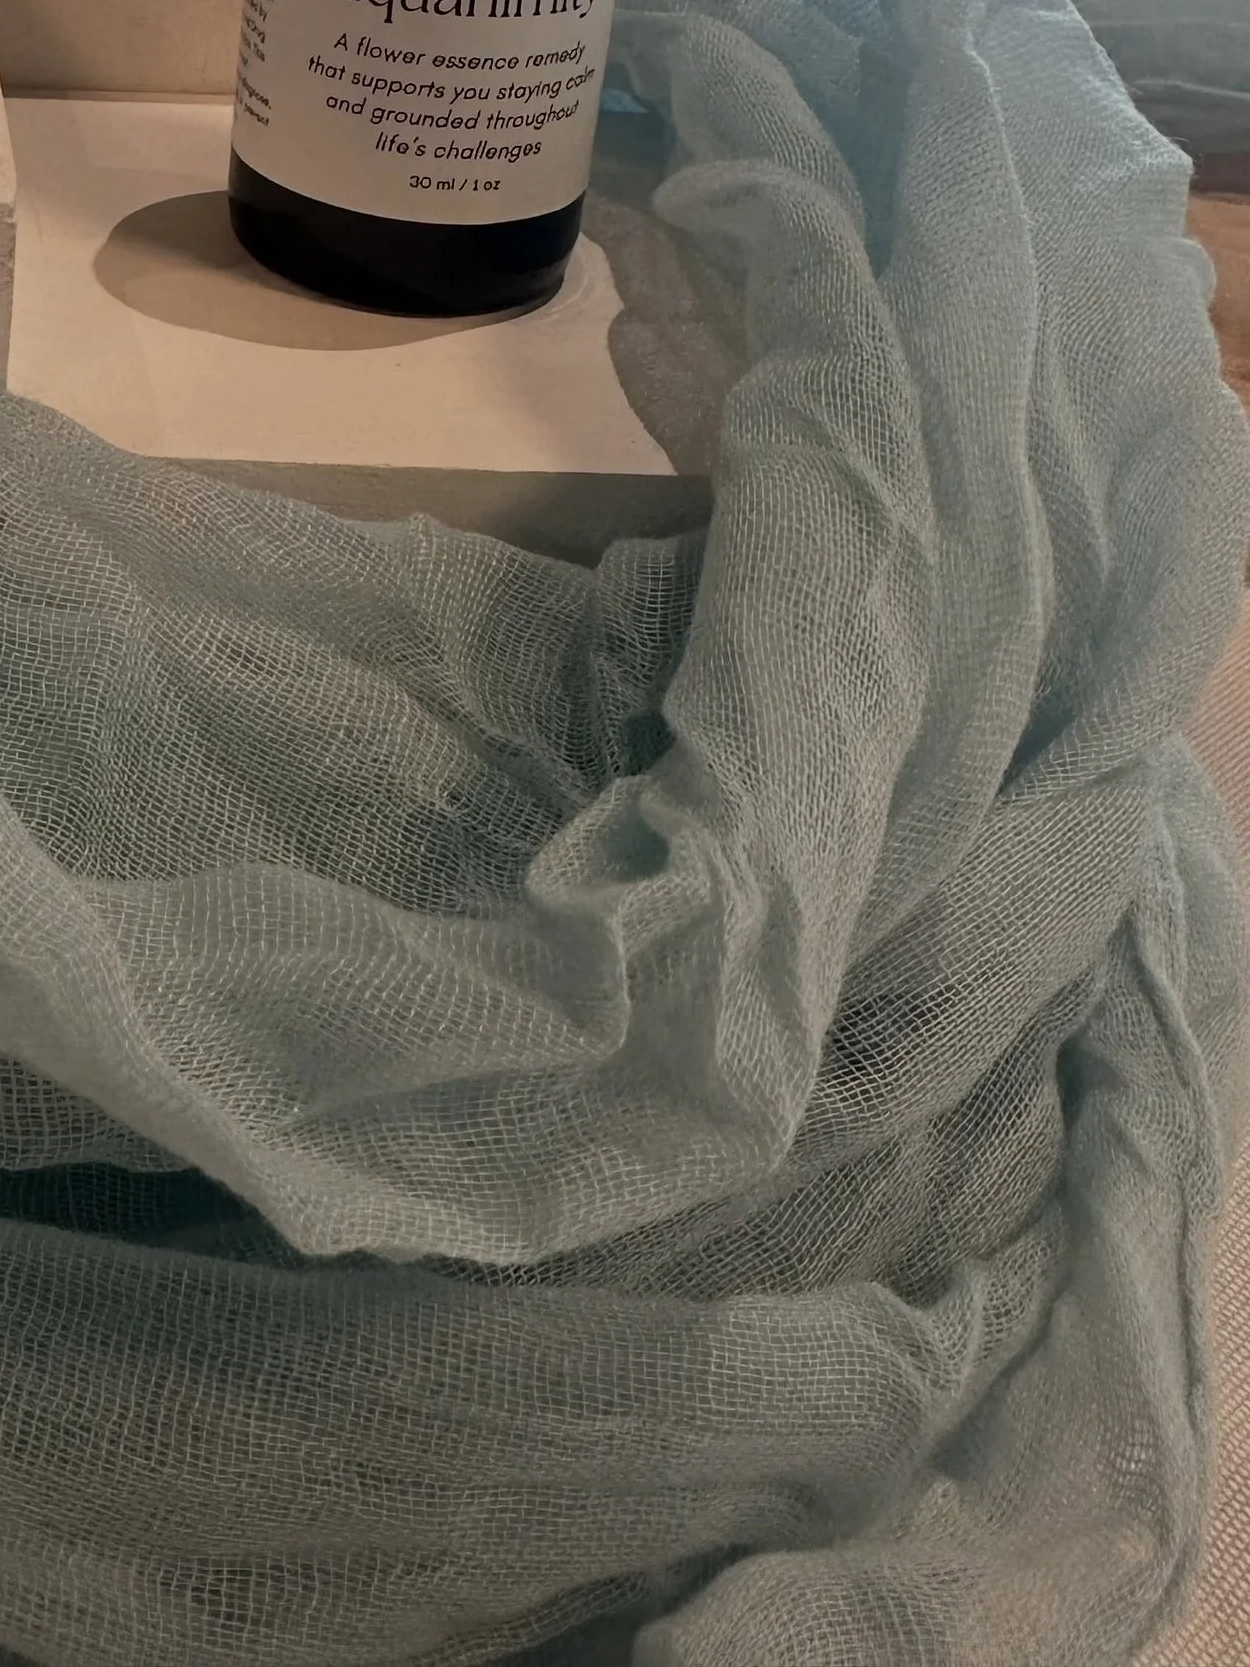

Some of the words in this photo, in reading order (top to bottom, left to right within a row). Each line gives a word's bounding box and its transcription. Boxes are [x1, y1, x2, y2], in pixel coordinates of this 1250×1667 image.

[333, 33, 350, 52] A
[357, 36, 427, 66] flower
[432, 54, 520, 71] essence
[525, 40, 586, 69] remedy
[307, 56, 346, 82] that
[351, 71, 445, 100] supports
[449, 84, 490, 105] you
[496, 78, 561, 108] staying
[326, 94, 366, 116] and
[370, 103, 479, 131] grounded
[485, 100, 579, 131] throughout
[375, 131, 427, 158] life's
[434, 140, 542, 164] challenges
[409, 175, 432, 191] 30
[436, 176, 456, 192] ml
[459, 178, 468, 192] /
[472, 179, 479, 192] 1
[483, 179, 501, 192] oz
